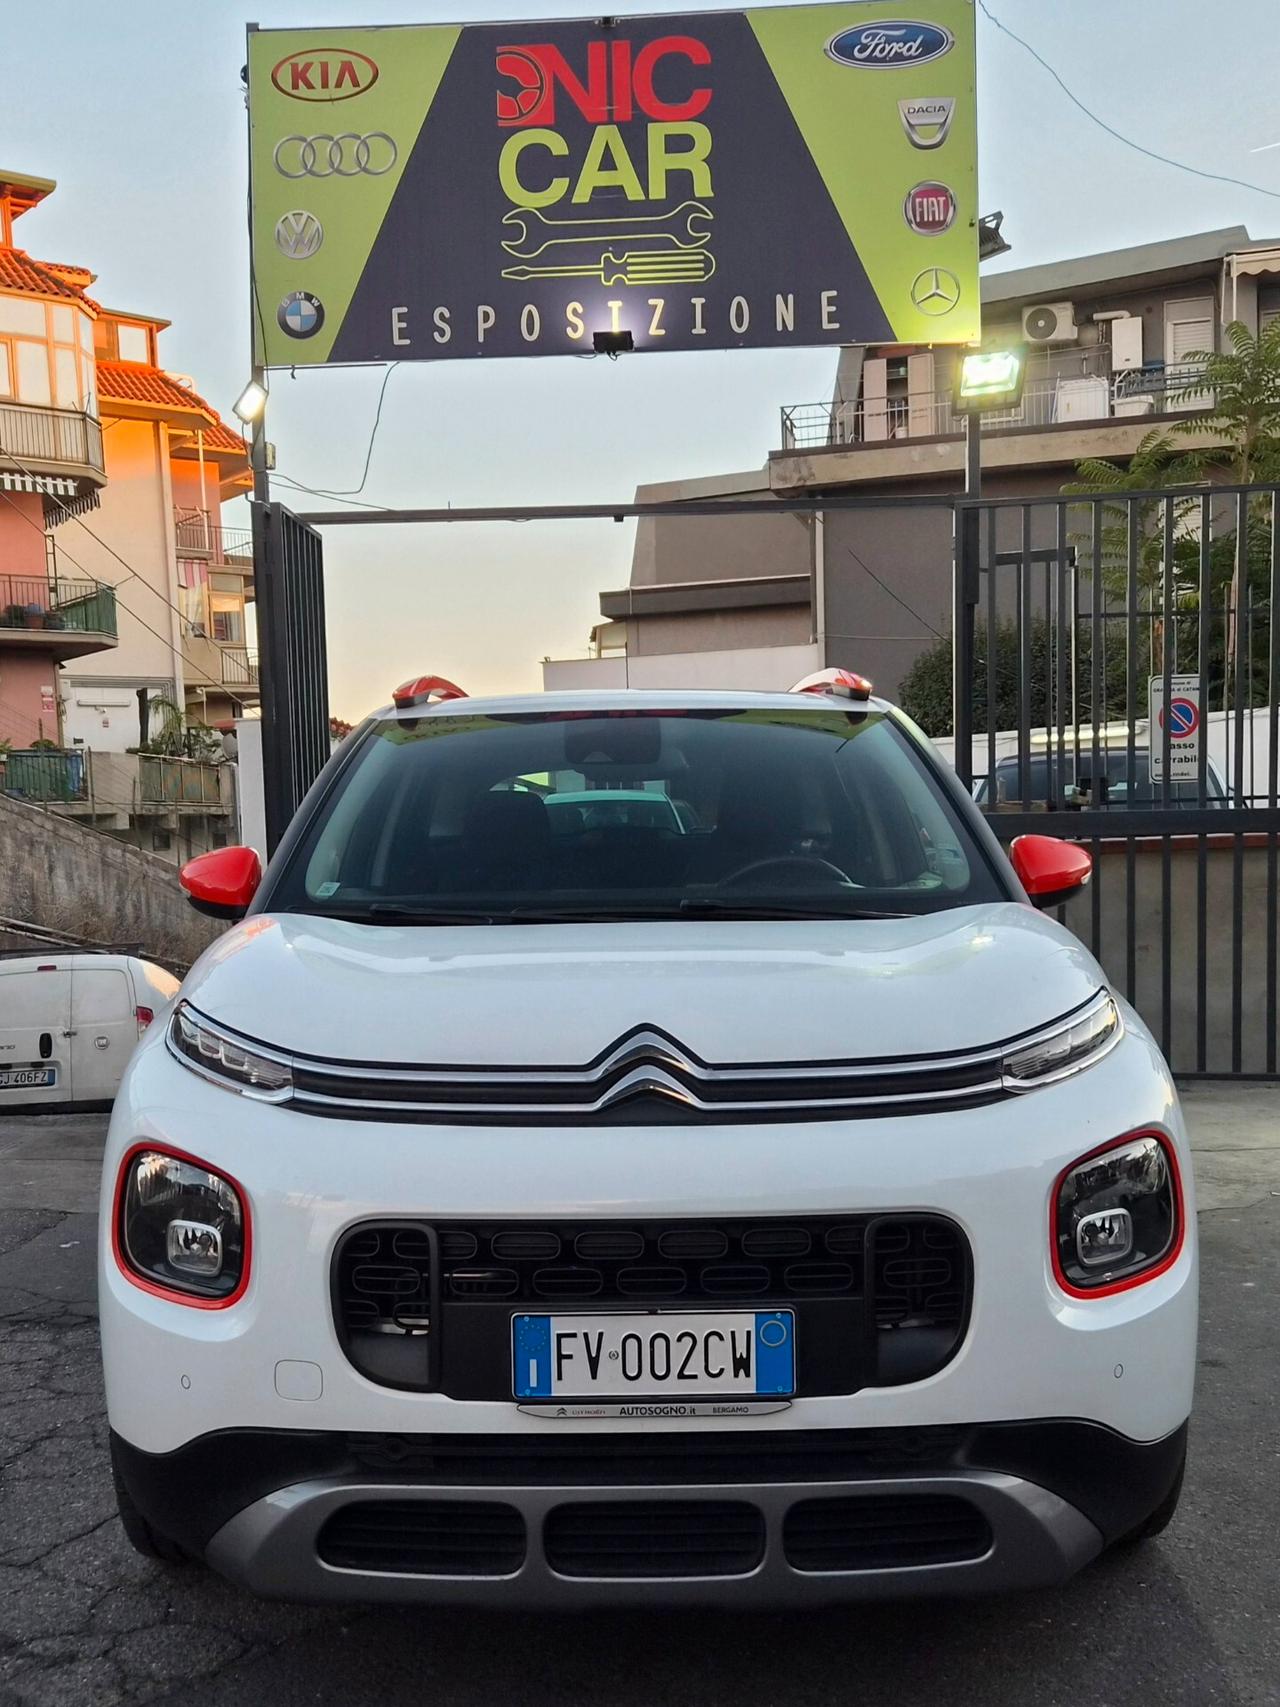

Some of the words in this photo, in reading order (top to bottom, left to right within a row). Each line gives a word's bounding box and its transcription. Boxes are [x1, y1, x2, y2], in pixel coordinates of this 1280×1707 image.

[853, 29, 923, 59] Ford
[290, 60, 360, 91] KIA
[907, 104, 946, 114] DACIA
[498, 121, 714, 209] CAR
[915, 196, 946, 222] FIAT
[281, 292, 321, 308] BMW
[391, 290, 840, 346] ESPOSIZIONE
[619, 1406, 696, 1416] AUTOSOGNO.it
[712, 1406, 749, 1414] BERGAMO
